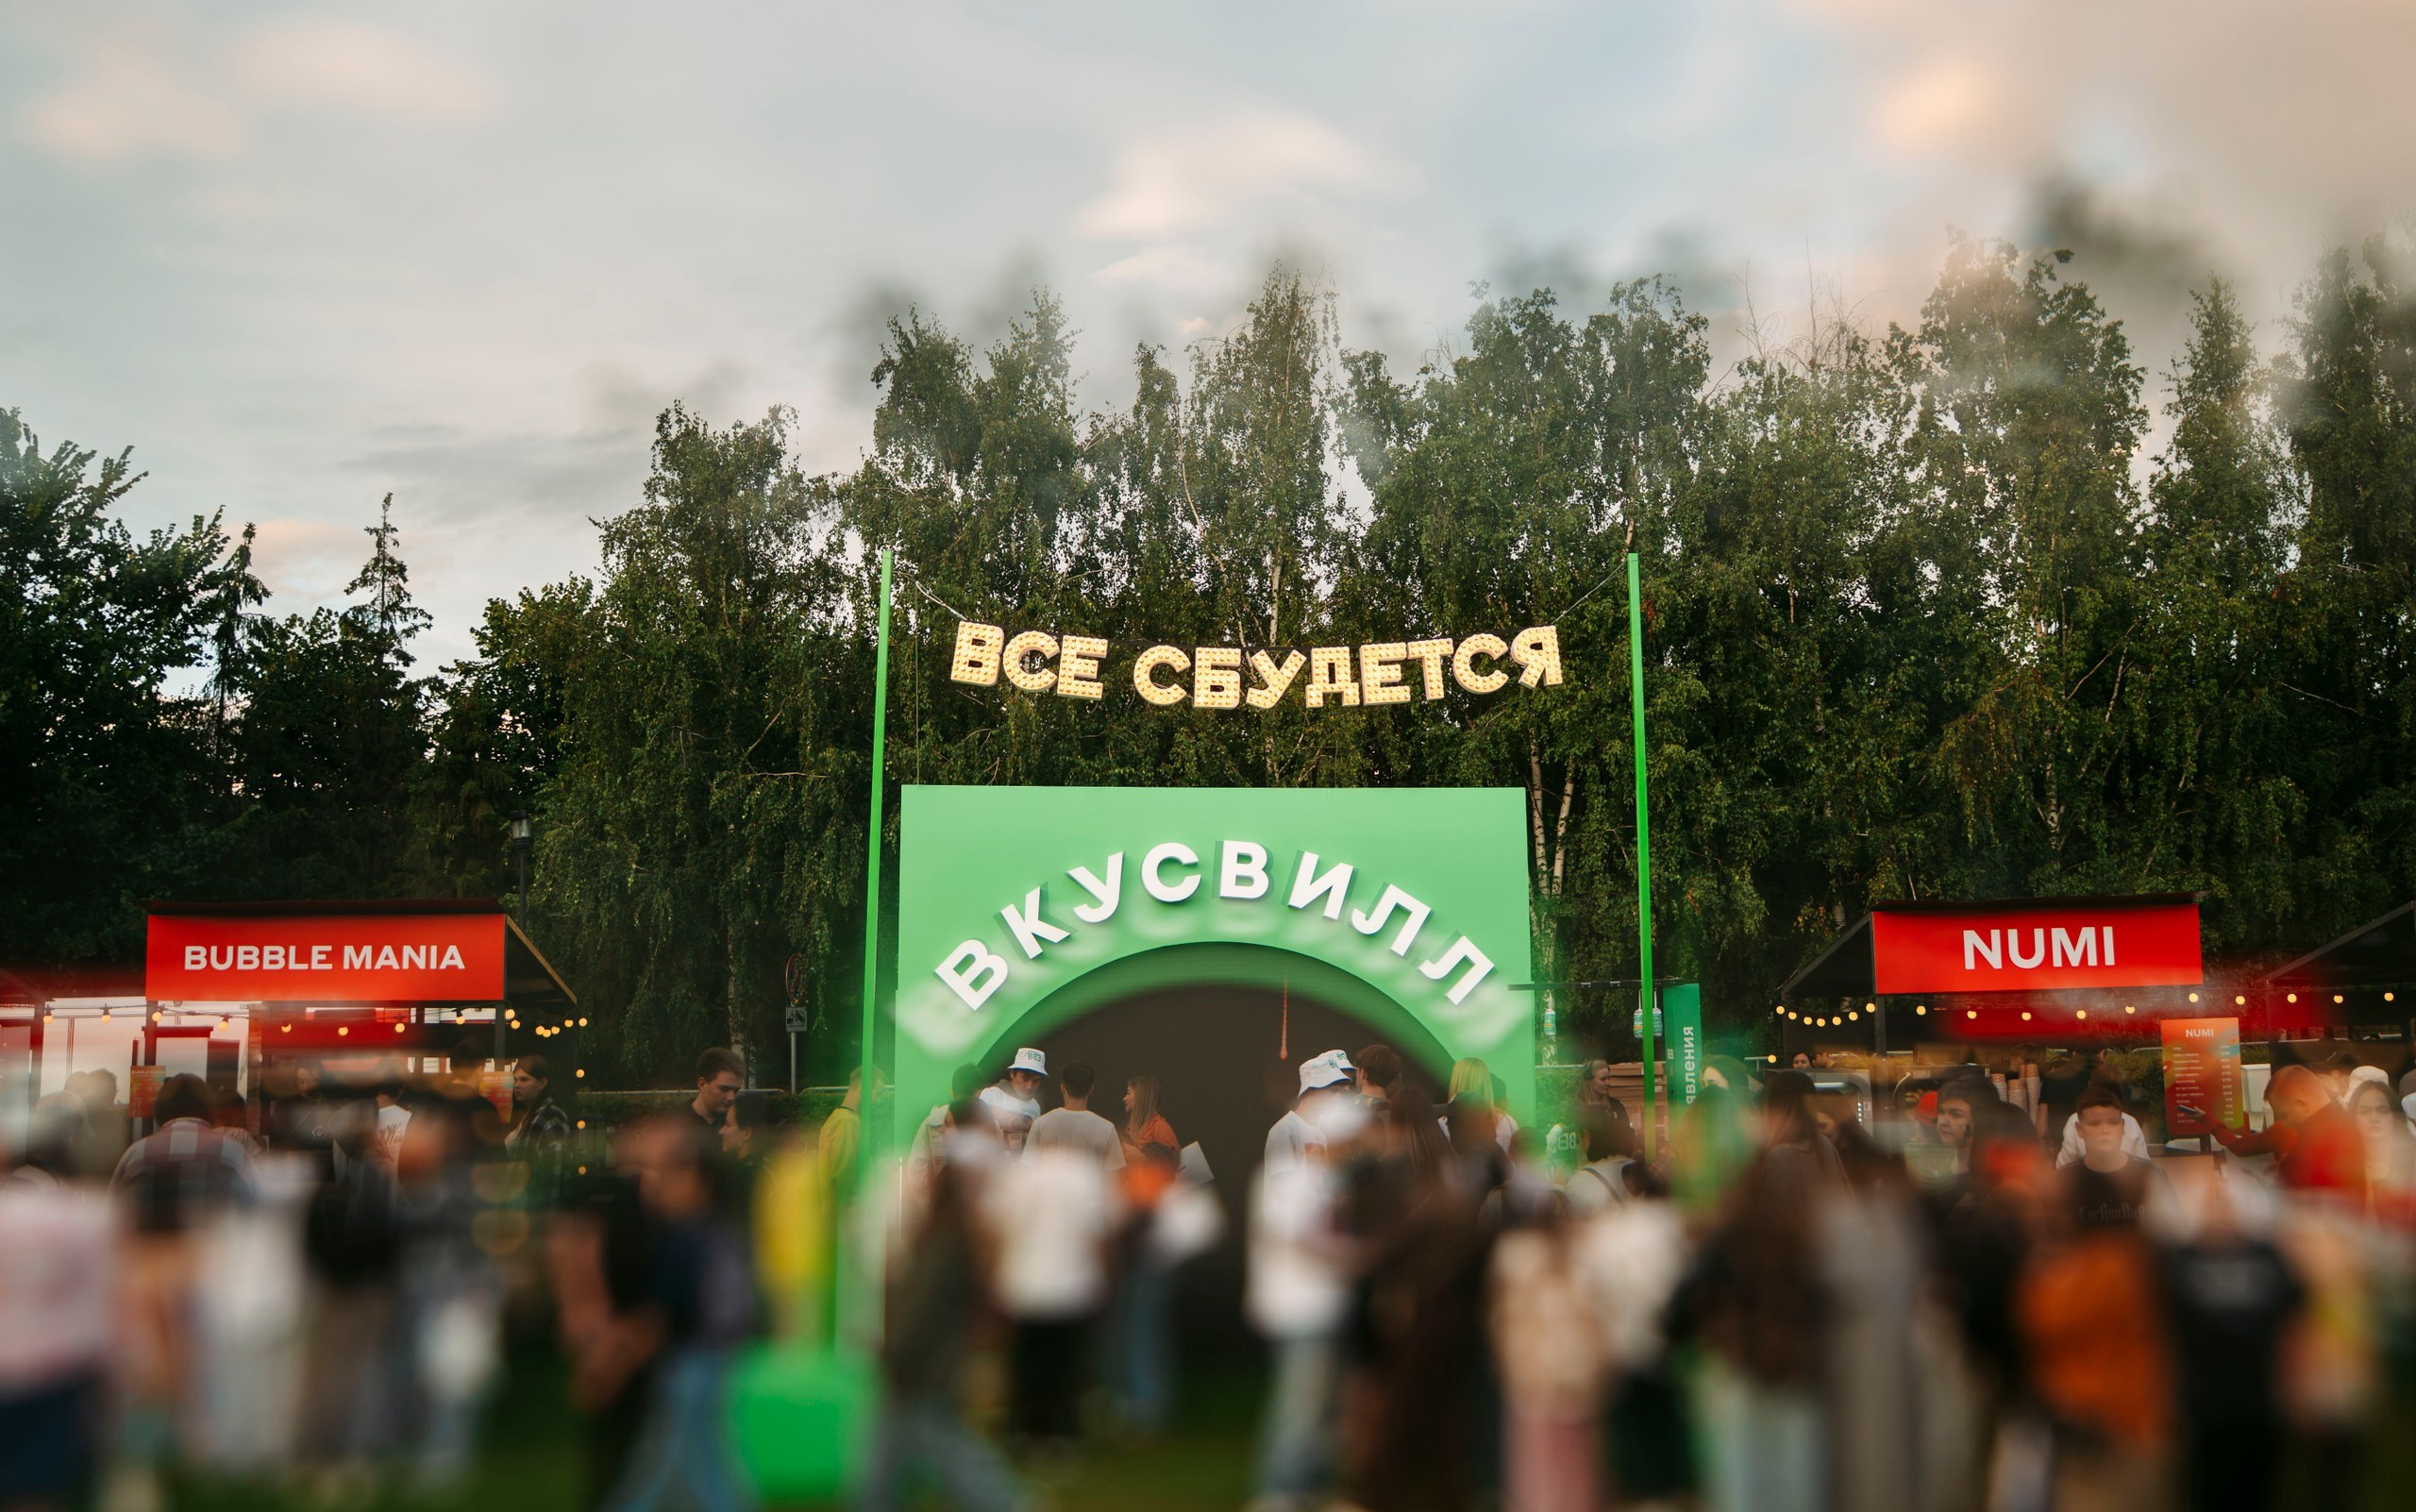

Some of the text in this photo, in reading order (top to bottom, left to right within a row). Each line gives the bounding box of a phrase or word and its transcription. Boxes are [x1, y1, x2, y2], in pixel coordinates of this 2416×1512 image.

[950, 621, 1564, 709] ВСЕ СБУДЕТСЯ
[933, 840, 1496, 1012] ВКУСВИЛЛ
[1962, 925, 2116, 970] NUMI
[184, 944, 466, 971] BUBBLE MANIA
[2185, 1028, 2214, 1038] NUMI
